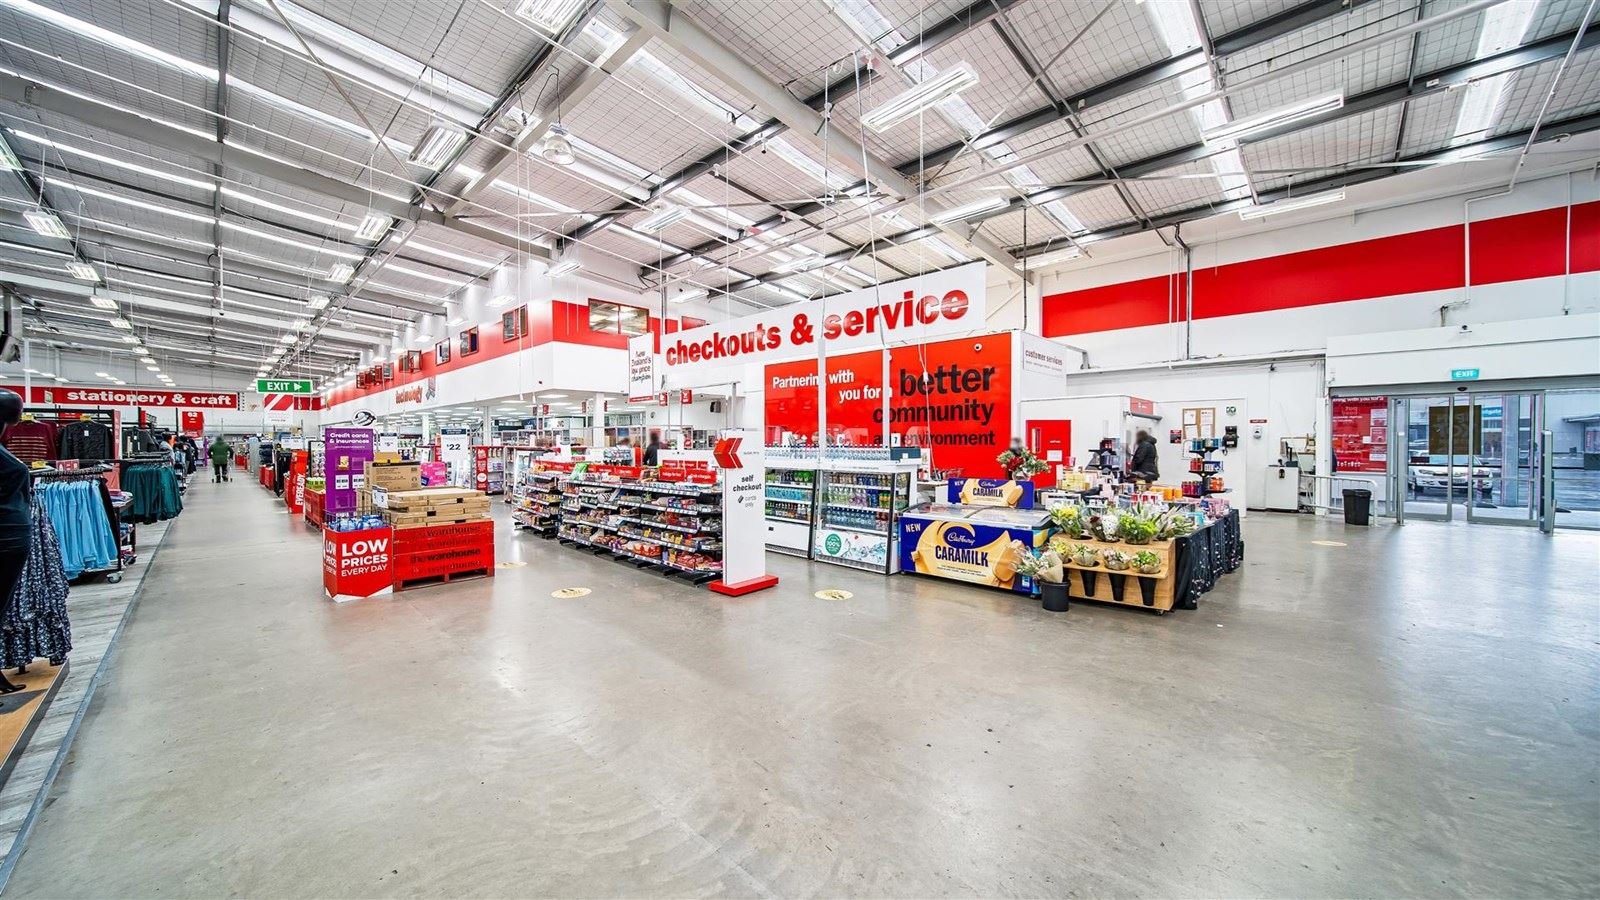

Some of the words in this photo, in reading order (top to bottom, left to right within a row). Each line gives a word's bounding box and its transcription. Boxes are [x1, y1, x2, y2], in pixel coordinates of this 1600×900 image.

[666, 323, 782, 366] checkouts
[790, 313, 814, 346] &
[823, 289, 969, 340] service
[1025, 350, 1046, 361] customer
[772, 373, 826, 389] Partnerin
[829, 369, 855, 385] with
[900, 364, 995, 397] better
[1455, 370, 1475, 378] EXIT
[266, 381, 290, 391] EXIT
[67, 389, 167, 406] stationery
[171, 393, 186, 404] &
[191, 393, 232, 406] craft
[839, 388, 860, 404] you
[863, 385, 880, 399] for
[873, 398, 995, 426] community
[741, 474, 754, 483] self
[295, 473, 305, 506] EVEREADY
[732, 483, 762, 492] checkout
[972, 487, 1004, 498] CARAMILK
[905, 523, 921, 533] NEW
[947, 531, 976, 546] Cadbury
[341, 538, 388, 557] LOW
[341, 553, 388, 569] PRICES
[935, 545, 989, 567] CARAMILK
[341, 566, 369, 577] EVERY
[370, 563, 387, 573] DAY
